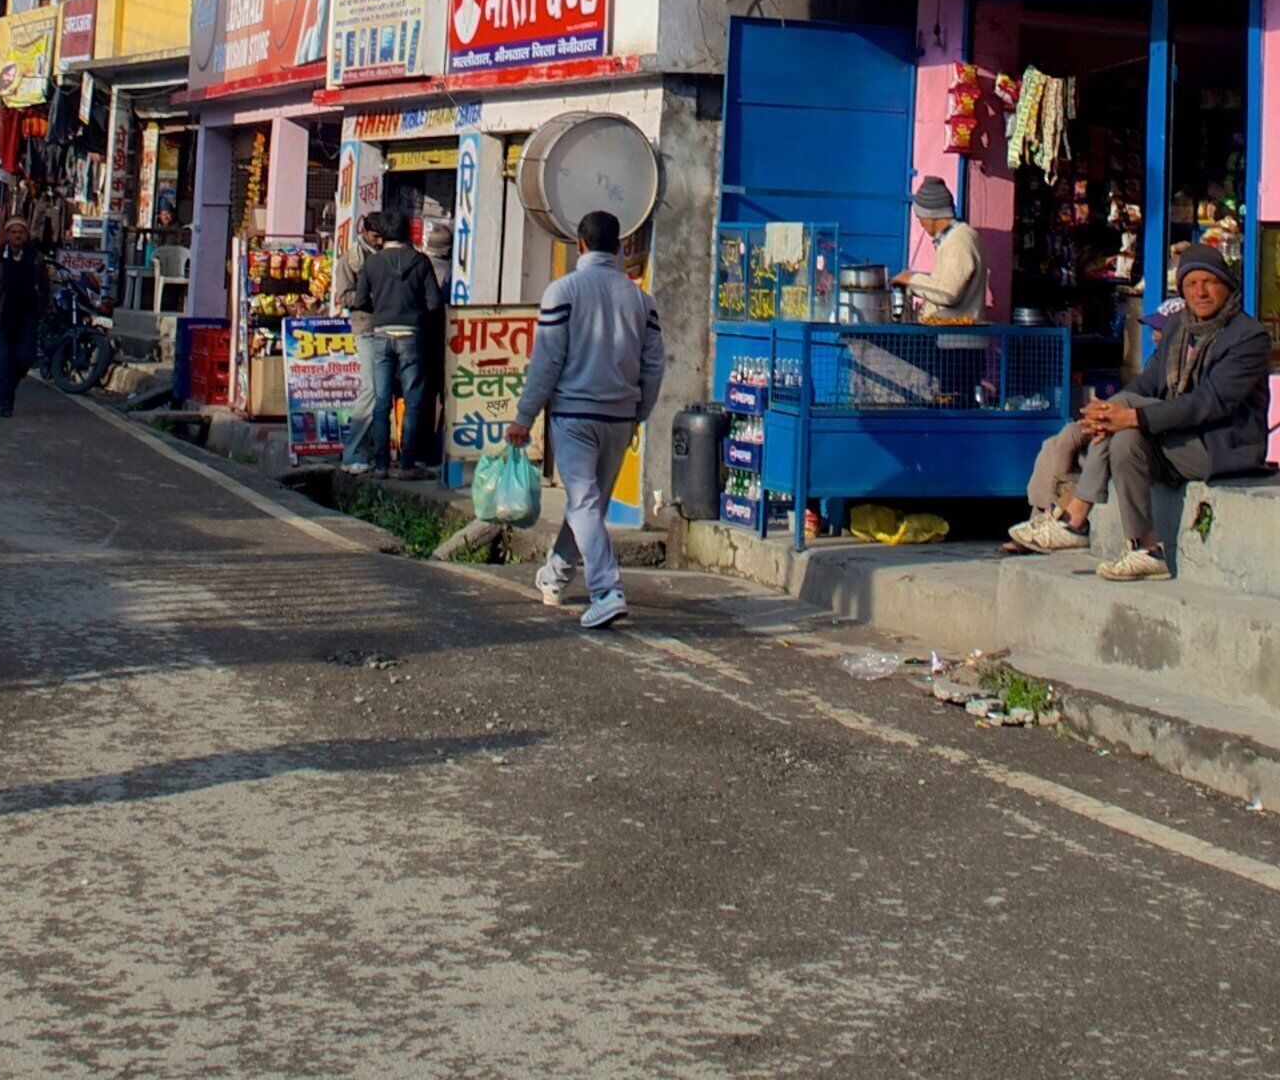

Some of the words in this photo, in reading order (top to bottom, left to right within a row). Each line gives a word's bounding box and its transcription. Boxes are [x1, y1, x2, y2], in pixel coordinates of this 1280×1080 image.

[495, 45, 531, 63] भीमताल
[532, 41, 556, 58] जिला
[558, 37, 598, 54] नैनीताल
[354, 110, 401, 137] AMAN
[292, 329, 357, 359] अम
[449, 318, 538, 359] भारत
